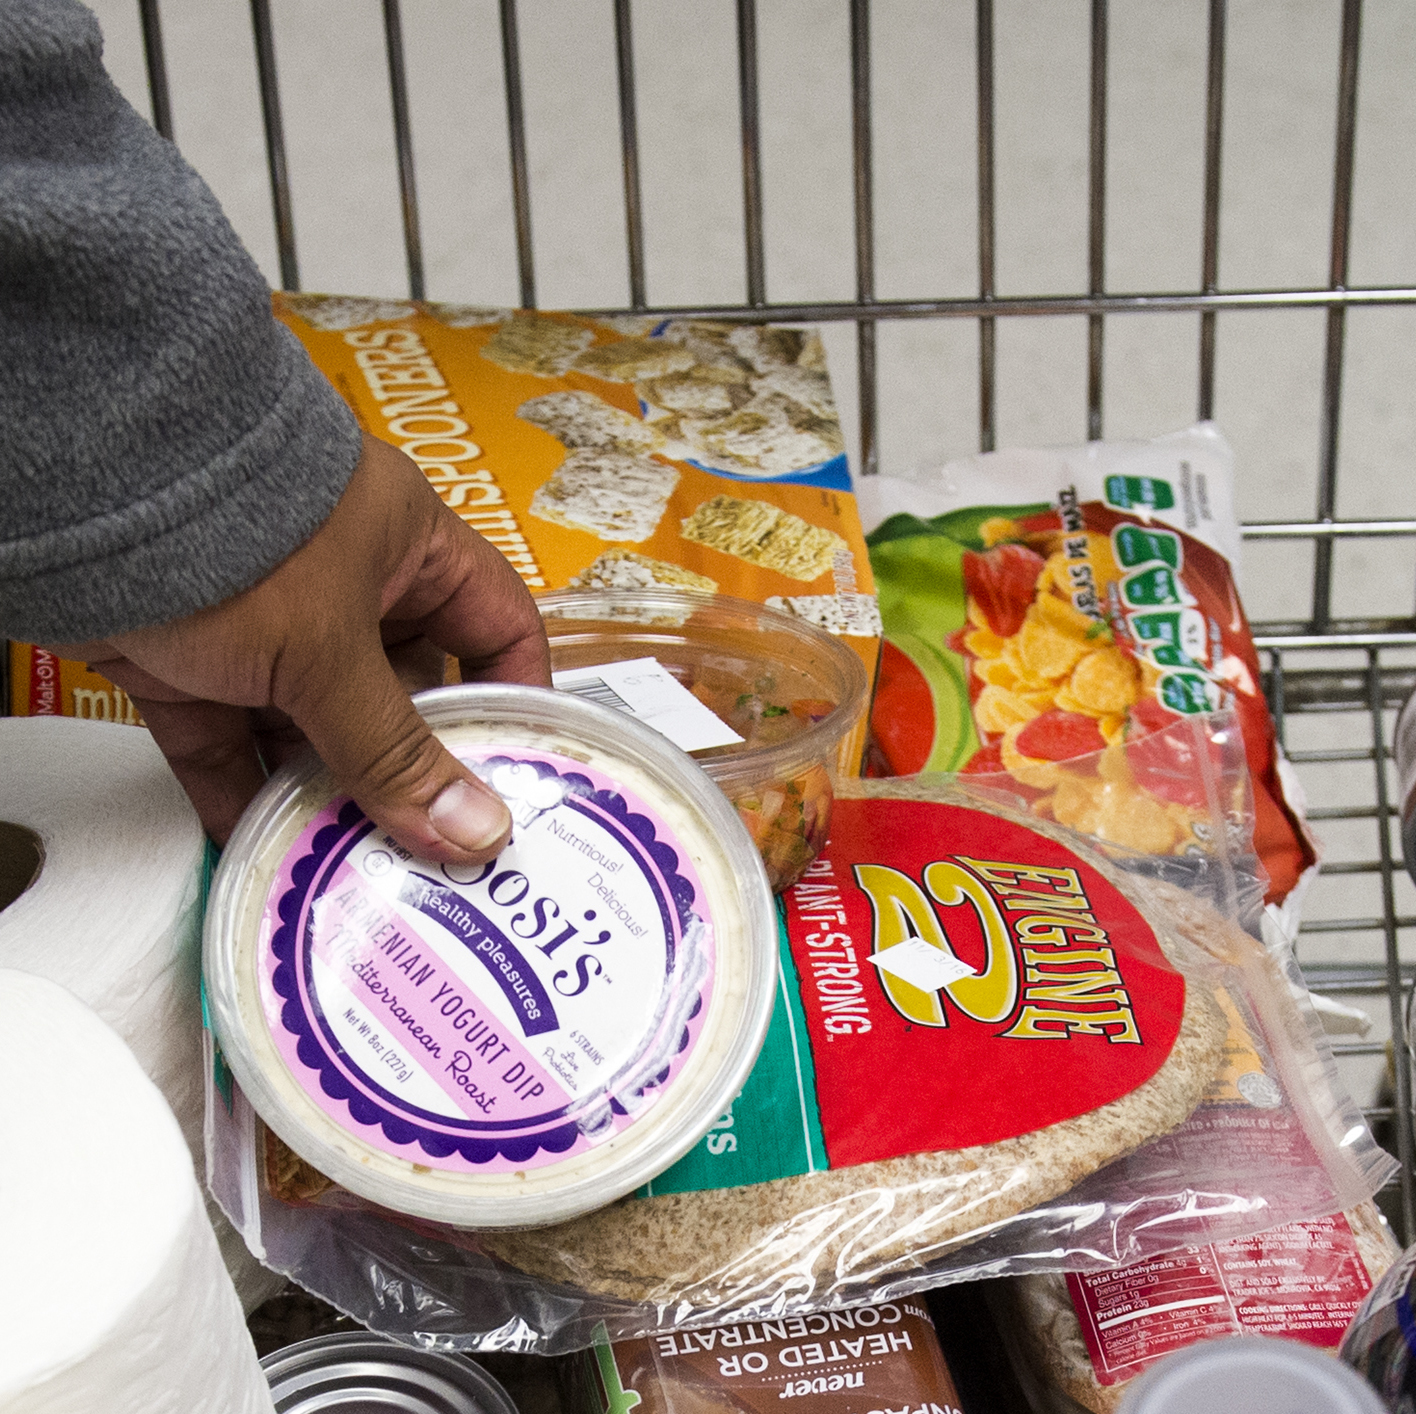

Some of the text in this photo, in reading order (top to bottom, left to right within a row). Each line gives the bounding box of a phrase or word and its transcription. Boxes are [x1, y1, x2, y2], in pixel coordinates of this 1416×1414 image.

[342, 326, 494, 508] SPOONERS
[547, 818, 625, 873] Nutritious!
[588, 872, 649, 940] Delicious!
[419, 887, 541, 1019] healthy pleasures
[851, 861, 1018, 1028] 2
[949, 855, 1144, 1045] ENGINE
[337, 887, 545, 1101] ARMENIAN YOGURT DIP
[326, 923, 499, 1114] Mediterranean Roast
[342, 1007, 415, 1083] Net Wt 8oz (227g)
[560, 1050, 580, 1072] Live
[575, 1034, 605, 1066] STRAINS
[542, 1046, 579, 1091] Probiotics
[1085, 1275, 1111, 1288] Total
[1111, 1261, 1174, 1280] Carbohydrate
[1223, 1259, 1257, 1271] CONTAINS
[1261, 1276, 1278, 1286] SOLD
[1094, 1282, 1124, 1298] Dietary
[1125, 1275, 1146, 1290] Fiber
[1147, 1273, 1160, 1285] 0g
[1098, 1290, 1140, 1309] Sugars 1g
[1232, 1287, 1258, 1297] TRADER
[1095, 1299, 1150, 1322] Protein 23g
[1101, 1323, 1131, 1339] Vitamin
[1140, 1316, 1155, 1326] 4%
[1168, 1307, 1199, 1320] Vitamin
[1239, 1304, 1266, 1315] COOKING
[1267, 1303, 1308, 1314] DIRECTIONS:
[1327, 1301, 1351, 1311] QUICKLY
[658, 1304, 903, 1358] CONCENTRATE
[1105, 1335, 1137, 1351] Calcium
[1173, 1321, 1190, 1331] Iron
[1244, 1320, 1333, 1333] TEMPERATURE SHOULD REACH
[717, 1330, 914, 1377] HEATED OR
[779, 1371, 866, 1399] never
